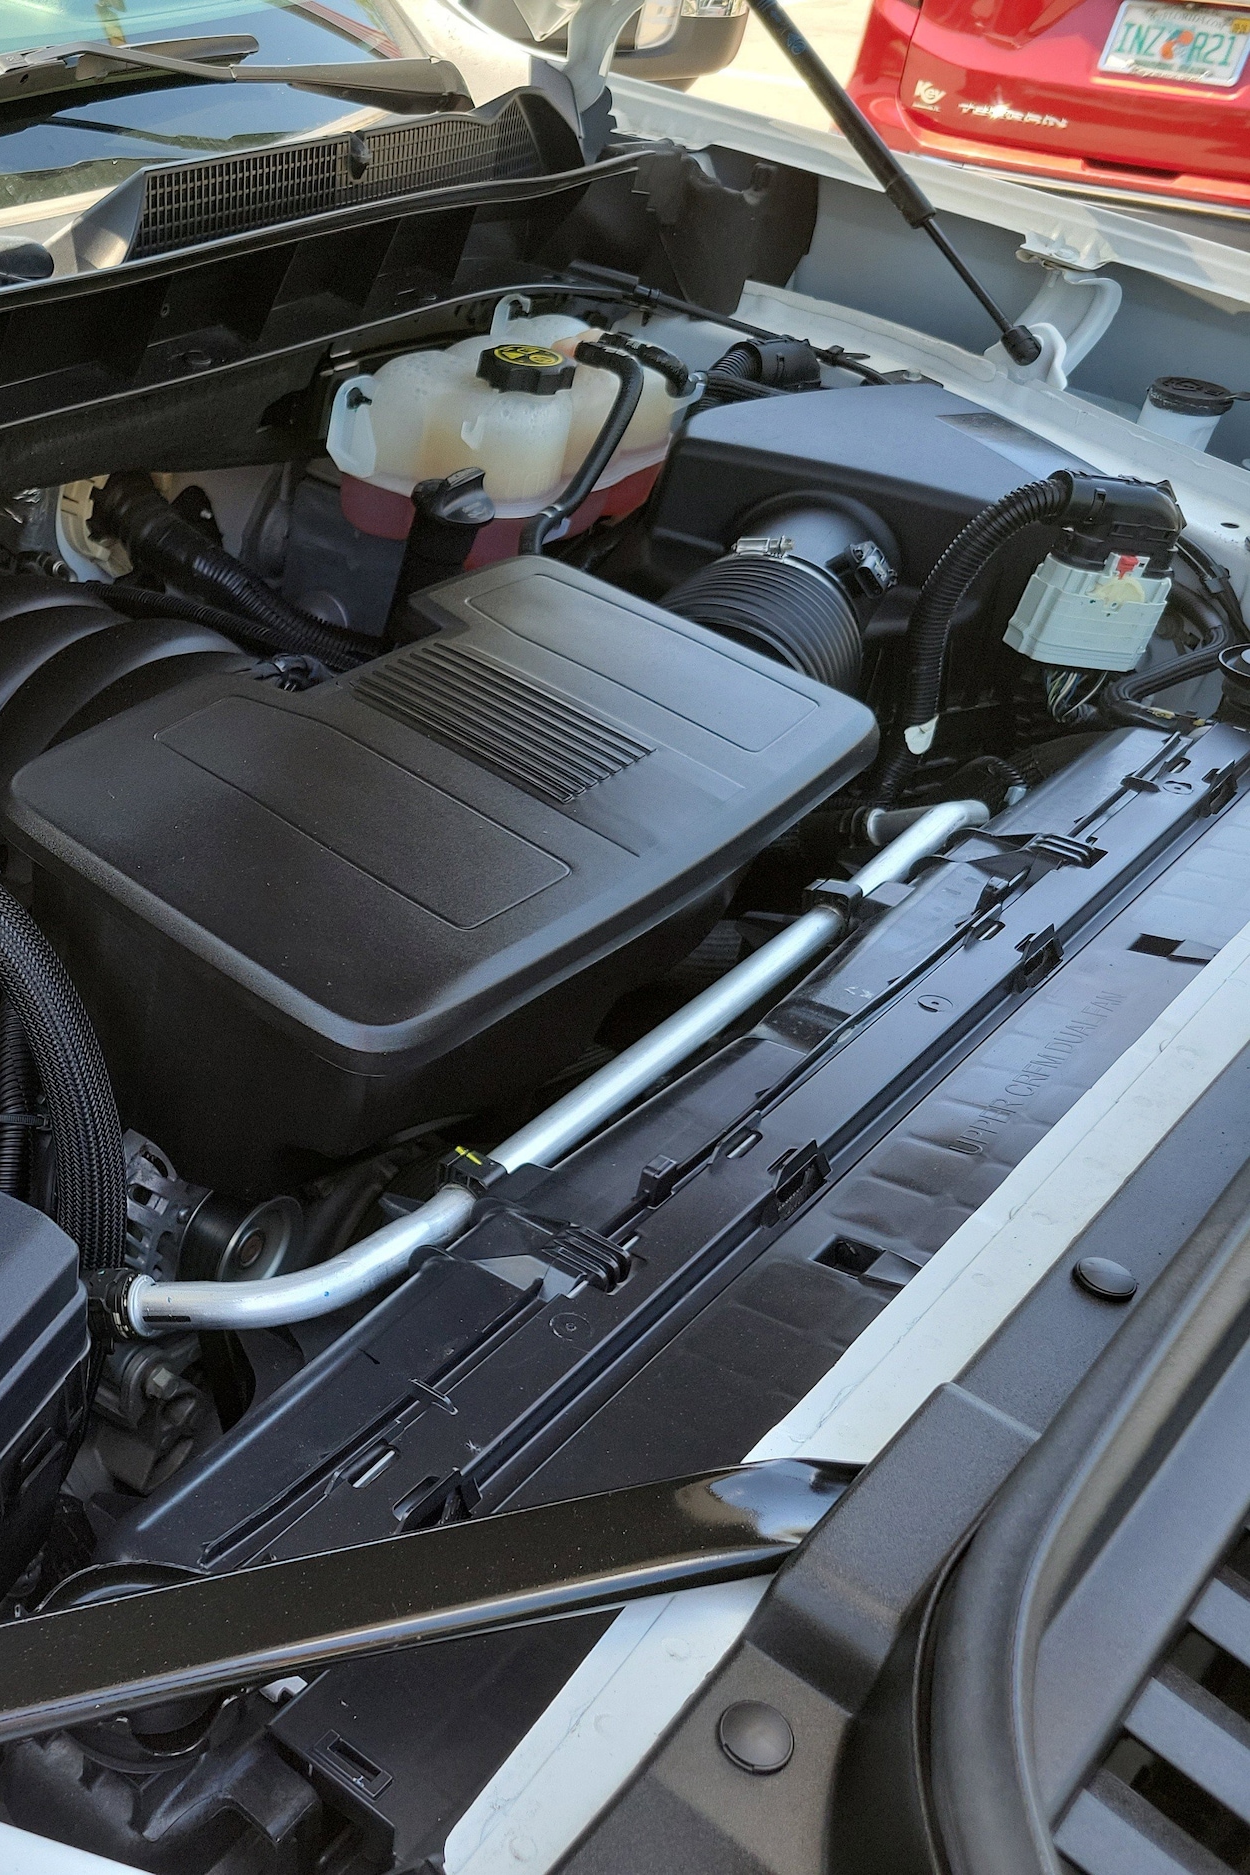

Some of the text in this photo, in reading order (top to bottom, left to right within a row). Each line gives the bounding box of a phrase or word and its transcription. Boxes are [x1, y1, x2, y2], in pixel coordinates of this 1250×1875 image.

[1115, 22, 1166, 56] INZ
[914, 79, 947, 105] Key
[948, 1097, 1024, 1156] UPPER
[1044, 1018, 1099, 1054] DUAL
[1080, 990, 1128, 1018] FAN
